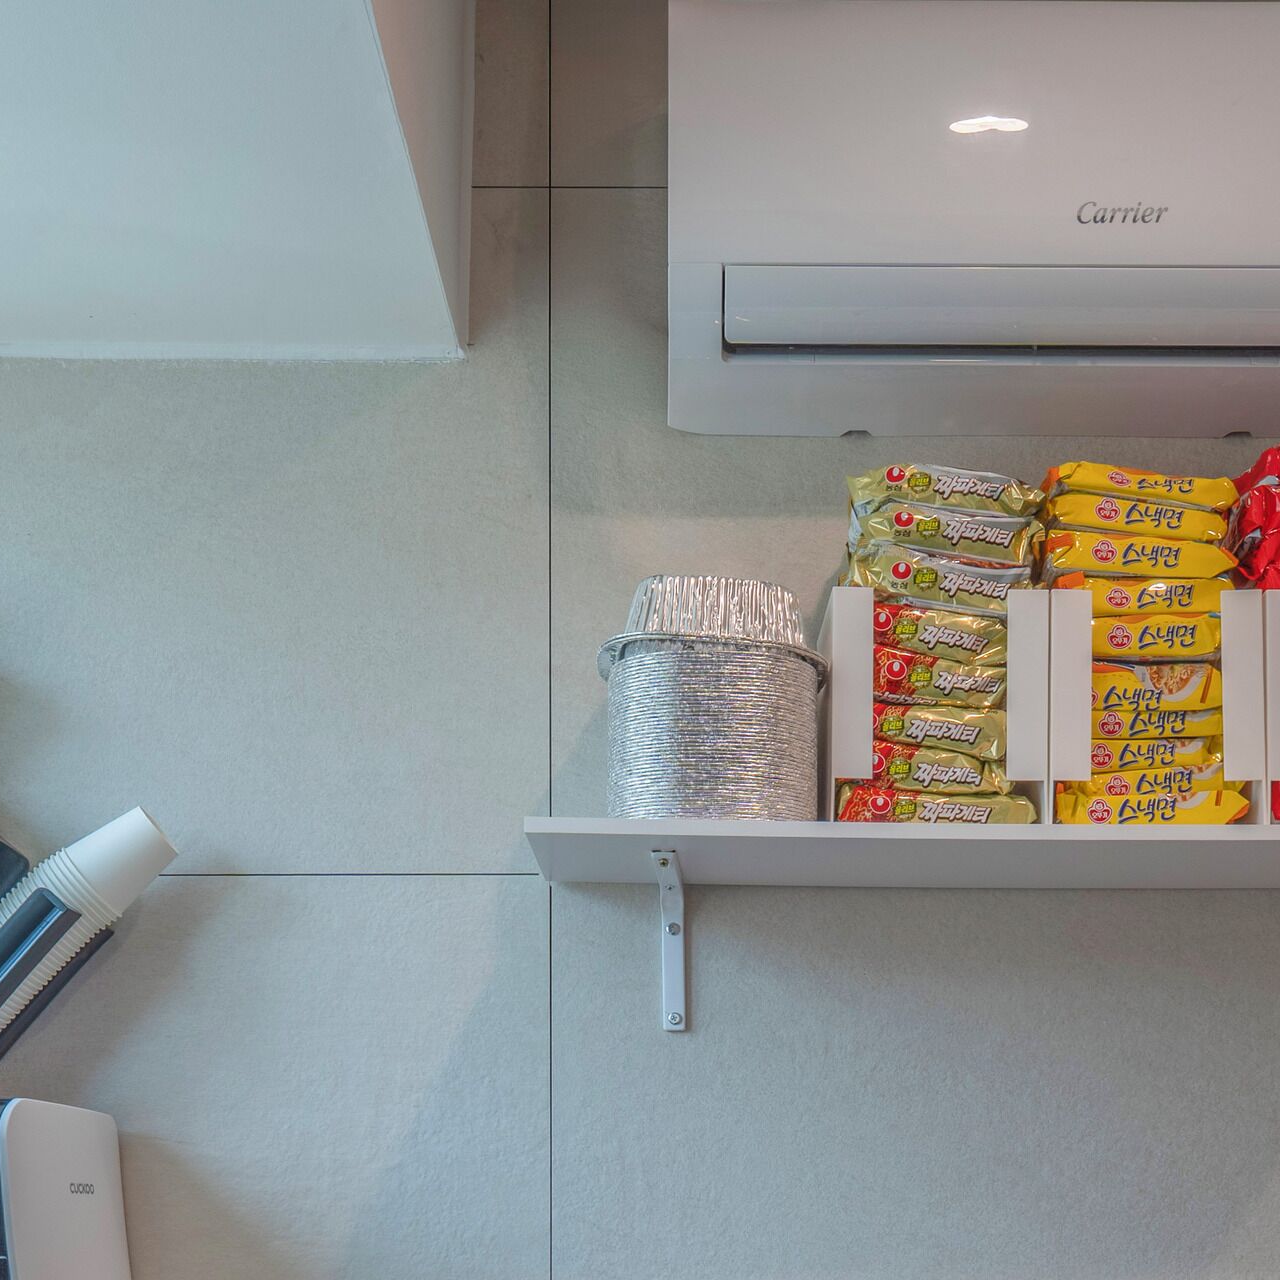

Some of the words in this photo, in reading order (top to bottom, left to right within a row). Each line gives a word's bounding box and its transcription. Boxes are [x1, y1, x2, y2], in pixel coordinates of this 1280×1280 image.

[1076, 200, 1169, 225] Carrier
[932, 474, 1006, 501] 짜파게티
[1124, 502, 1185, 530] 스낵면
[941, 518, 1015, 549] 짜파게티
[1121, 542, 1181, 569] 스낵면
[938, 570, 1010, 600] 짜파게티
[1136, 583, 1195, 609] 스낵면
[918, 624, 990, 655] 짜파게티
[1138, 623, 1198, 650] 스낵면
[933, 670, 1004, 697] 짜파게티
[1102, 685, 1163, 712] 스낵면
[905, 718, 980, 744] 짜파게티
[1128, 710, 1187, 738] 스낵면
[1118, 742, 1176, 769] 스낵면
[1136, 768, 1193, 796] 스낵면
[918, 802, 992, 824] 짜파게티
[1117, 796, 1178, 824] 스낵면
[69, 1182, 95, 1195] CUCKOO
